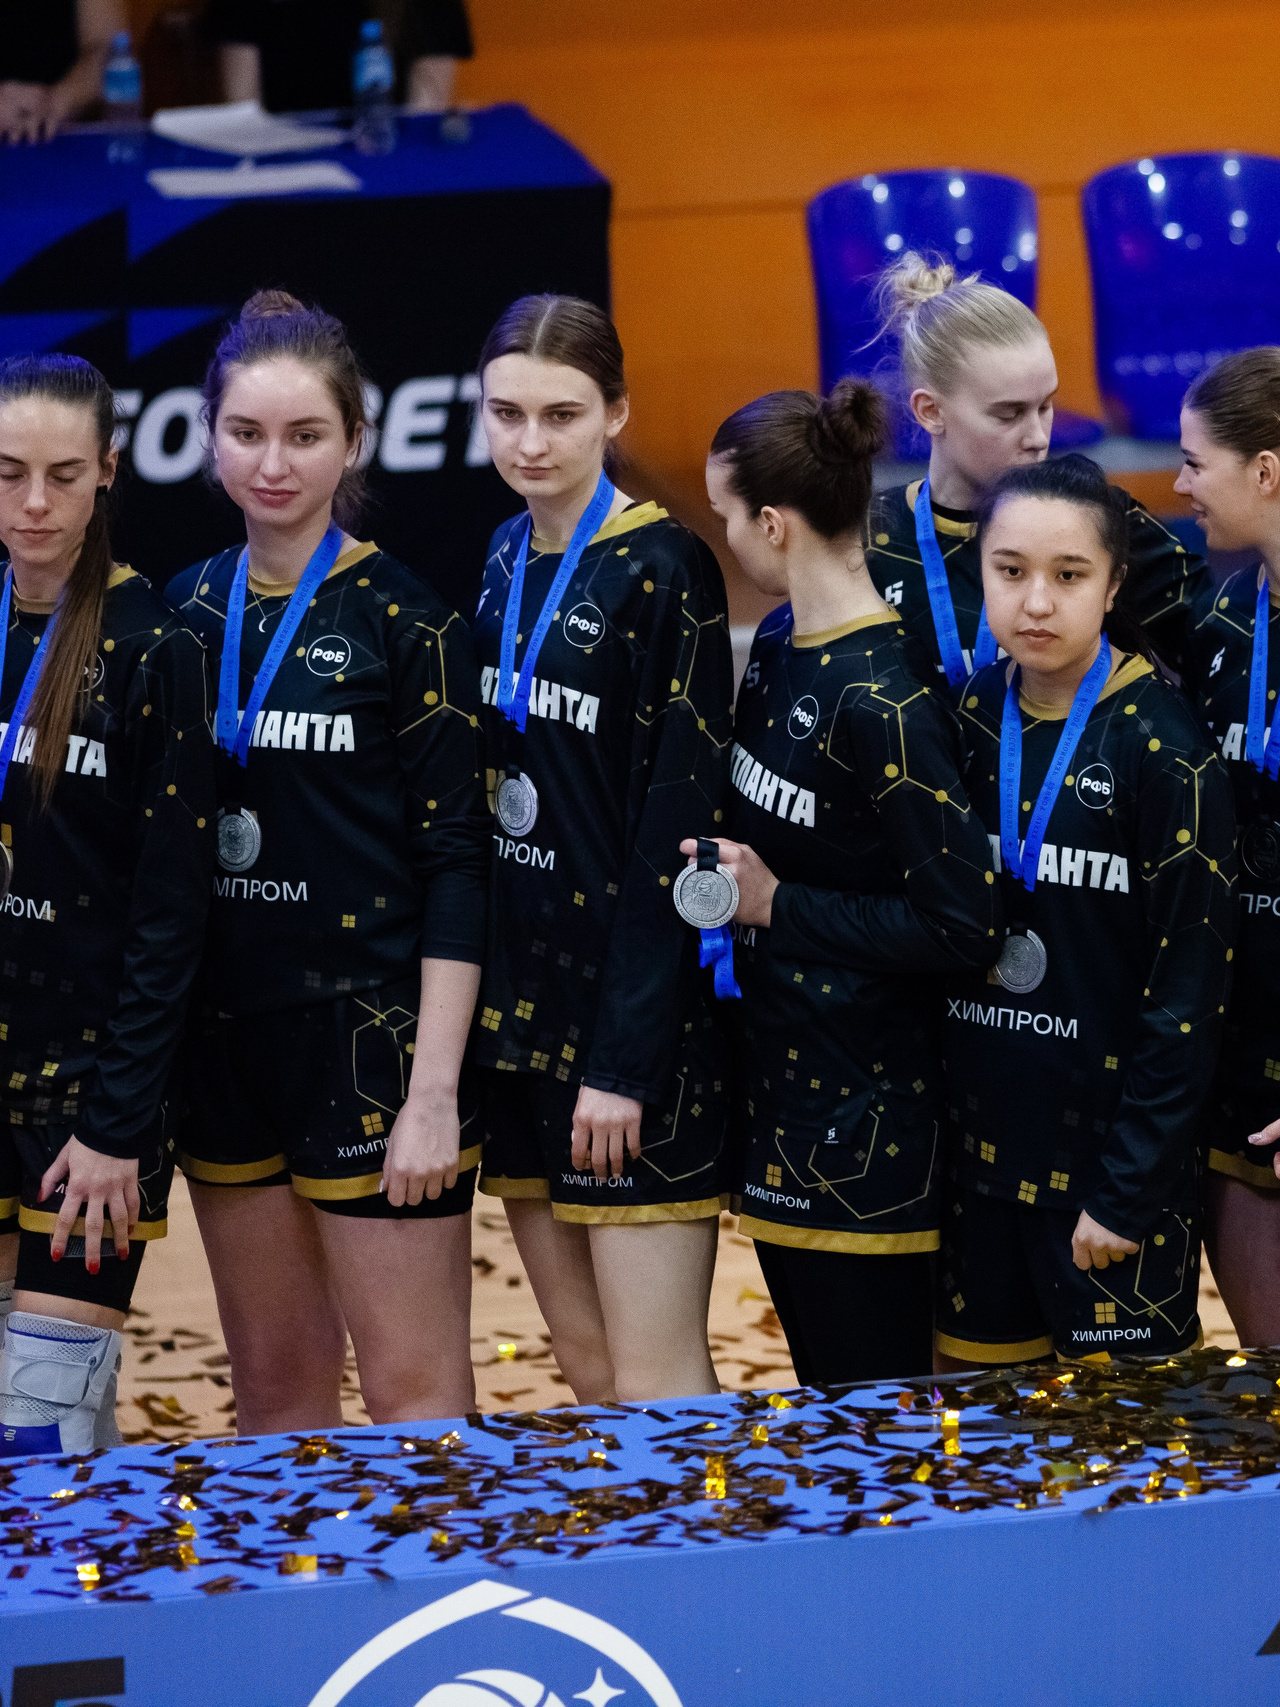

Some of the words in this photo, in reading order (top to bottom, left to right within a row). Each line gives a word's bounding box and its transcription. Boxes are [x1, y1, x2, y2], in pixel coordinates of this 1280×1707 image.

[568, 615, 600, 636] РФБ
[312, 648, 345, 663] РФБ
[792, 706, 814, 728] РФБ
[1081, 777, 1111, 796] РФБ
[947, 997, 1079, 1040] ХИМПРОМ
[744, 1182, 810, 1210] ХИМПРОМ
[1072, 1327, 1151, 1342] ХИМПРОМ
